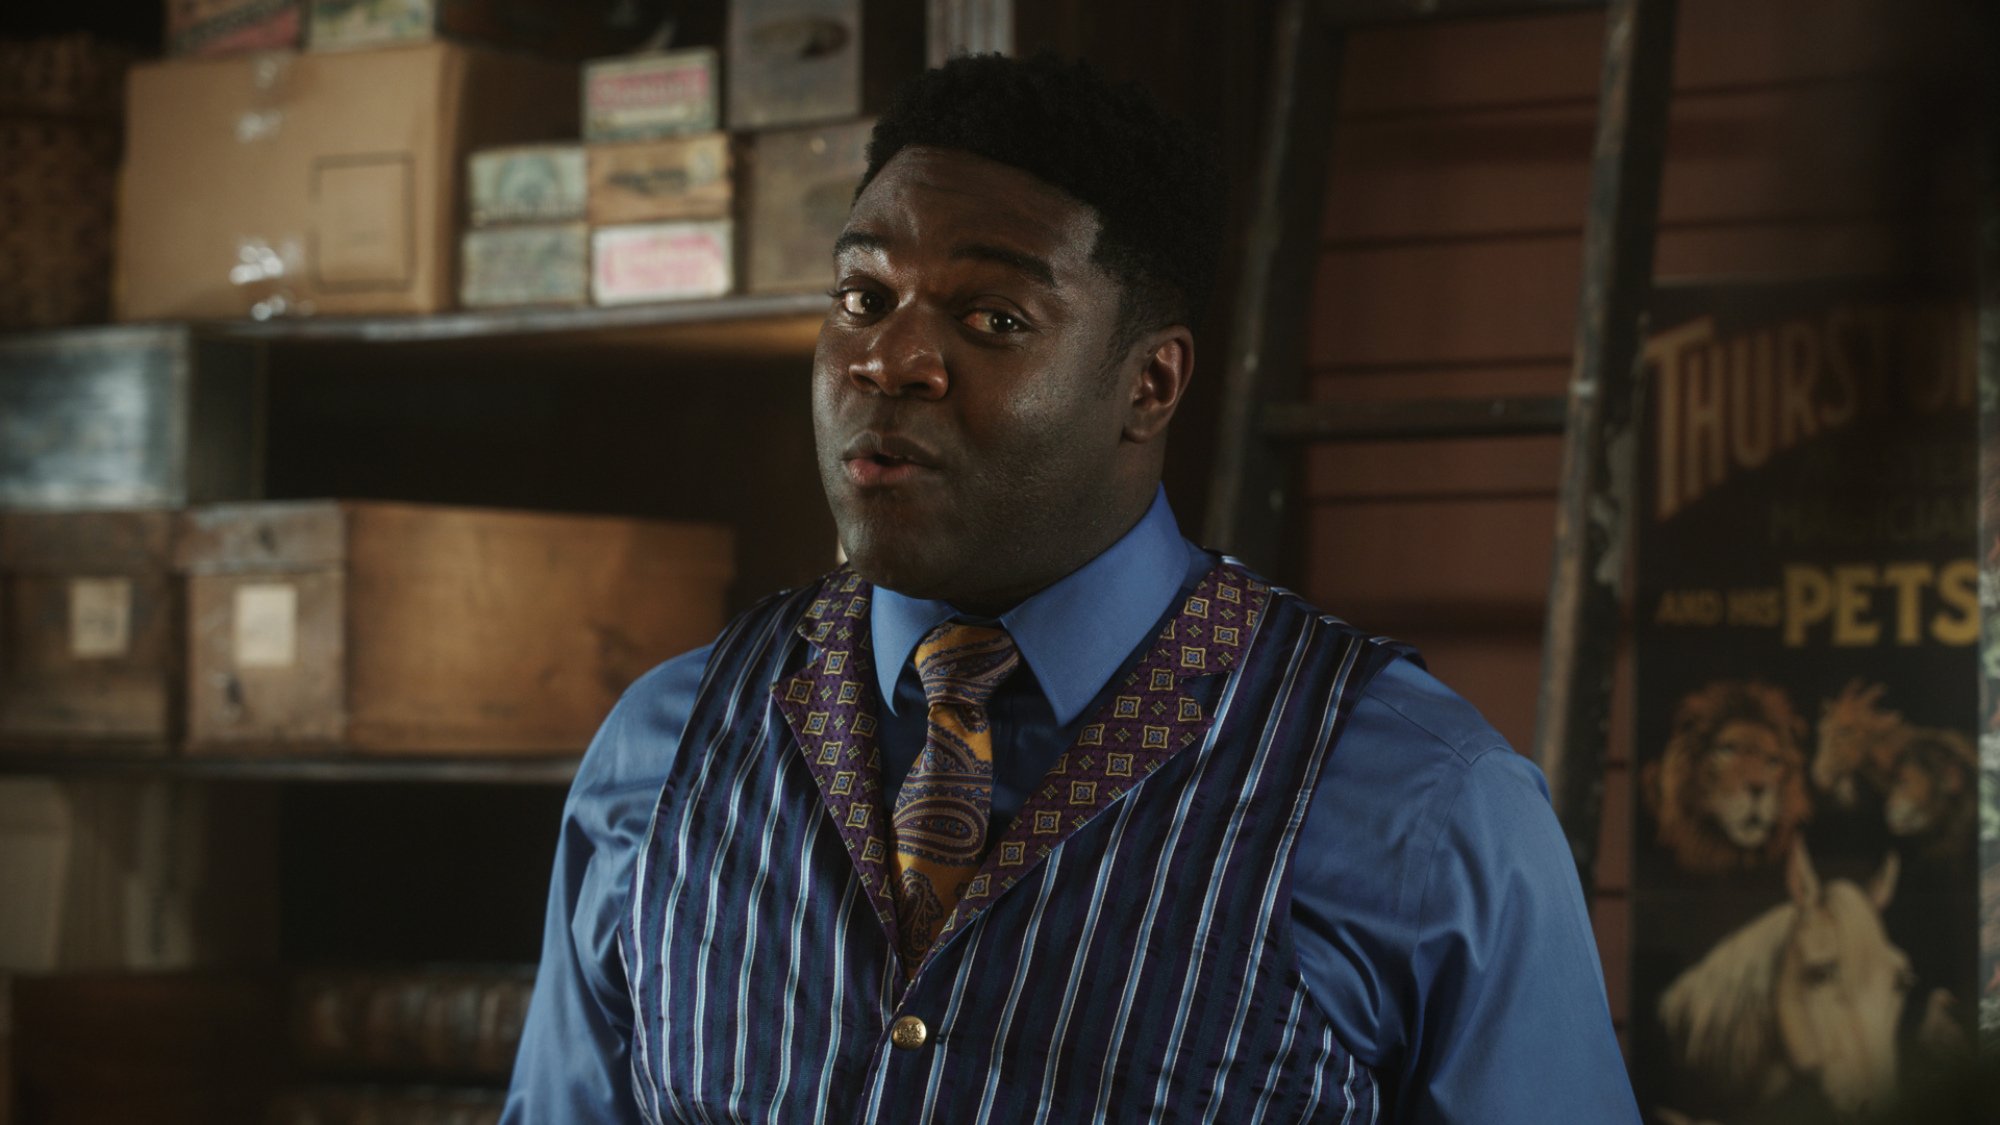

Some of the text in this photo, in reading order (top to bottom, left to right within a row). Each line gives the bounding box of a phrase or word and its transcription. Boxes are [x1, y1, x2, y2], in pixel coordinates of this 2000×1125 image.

[1655, 558, 1980, 648] AND HIS PETS
